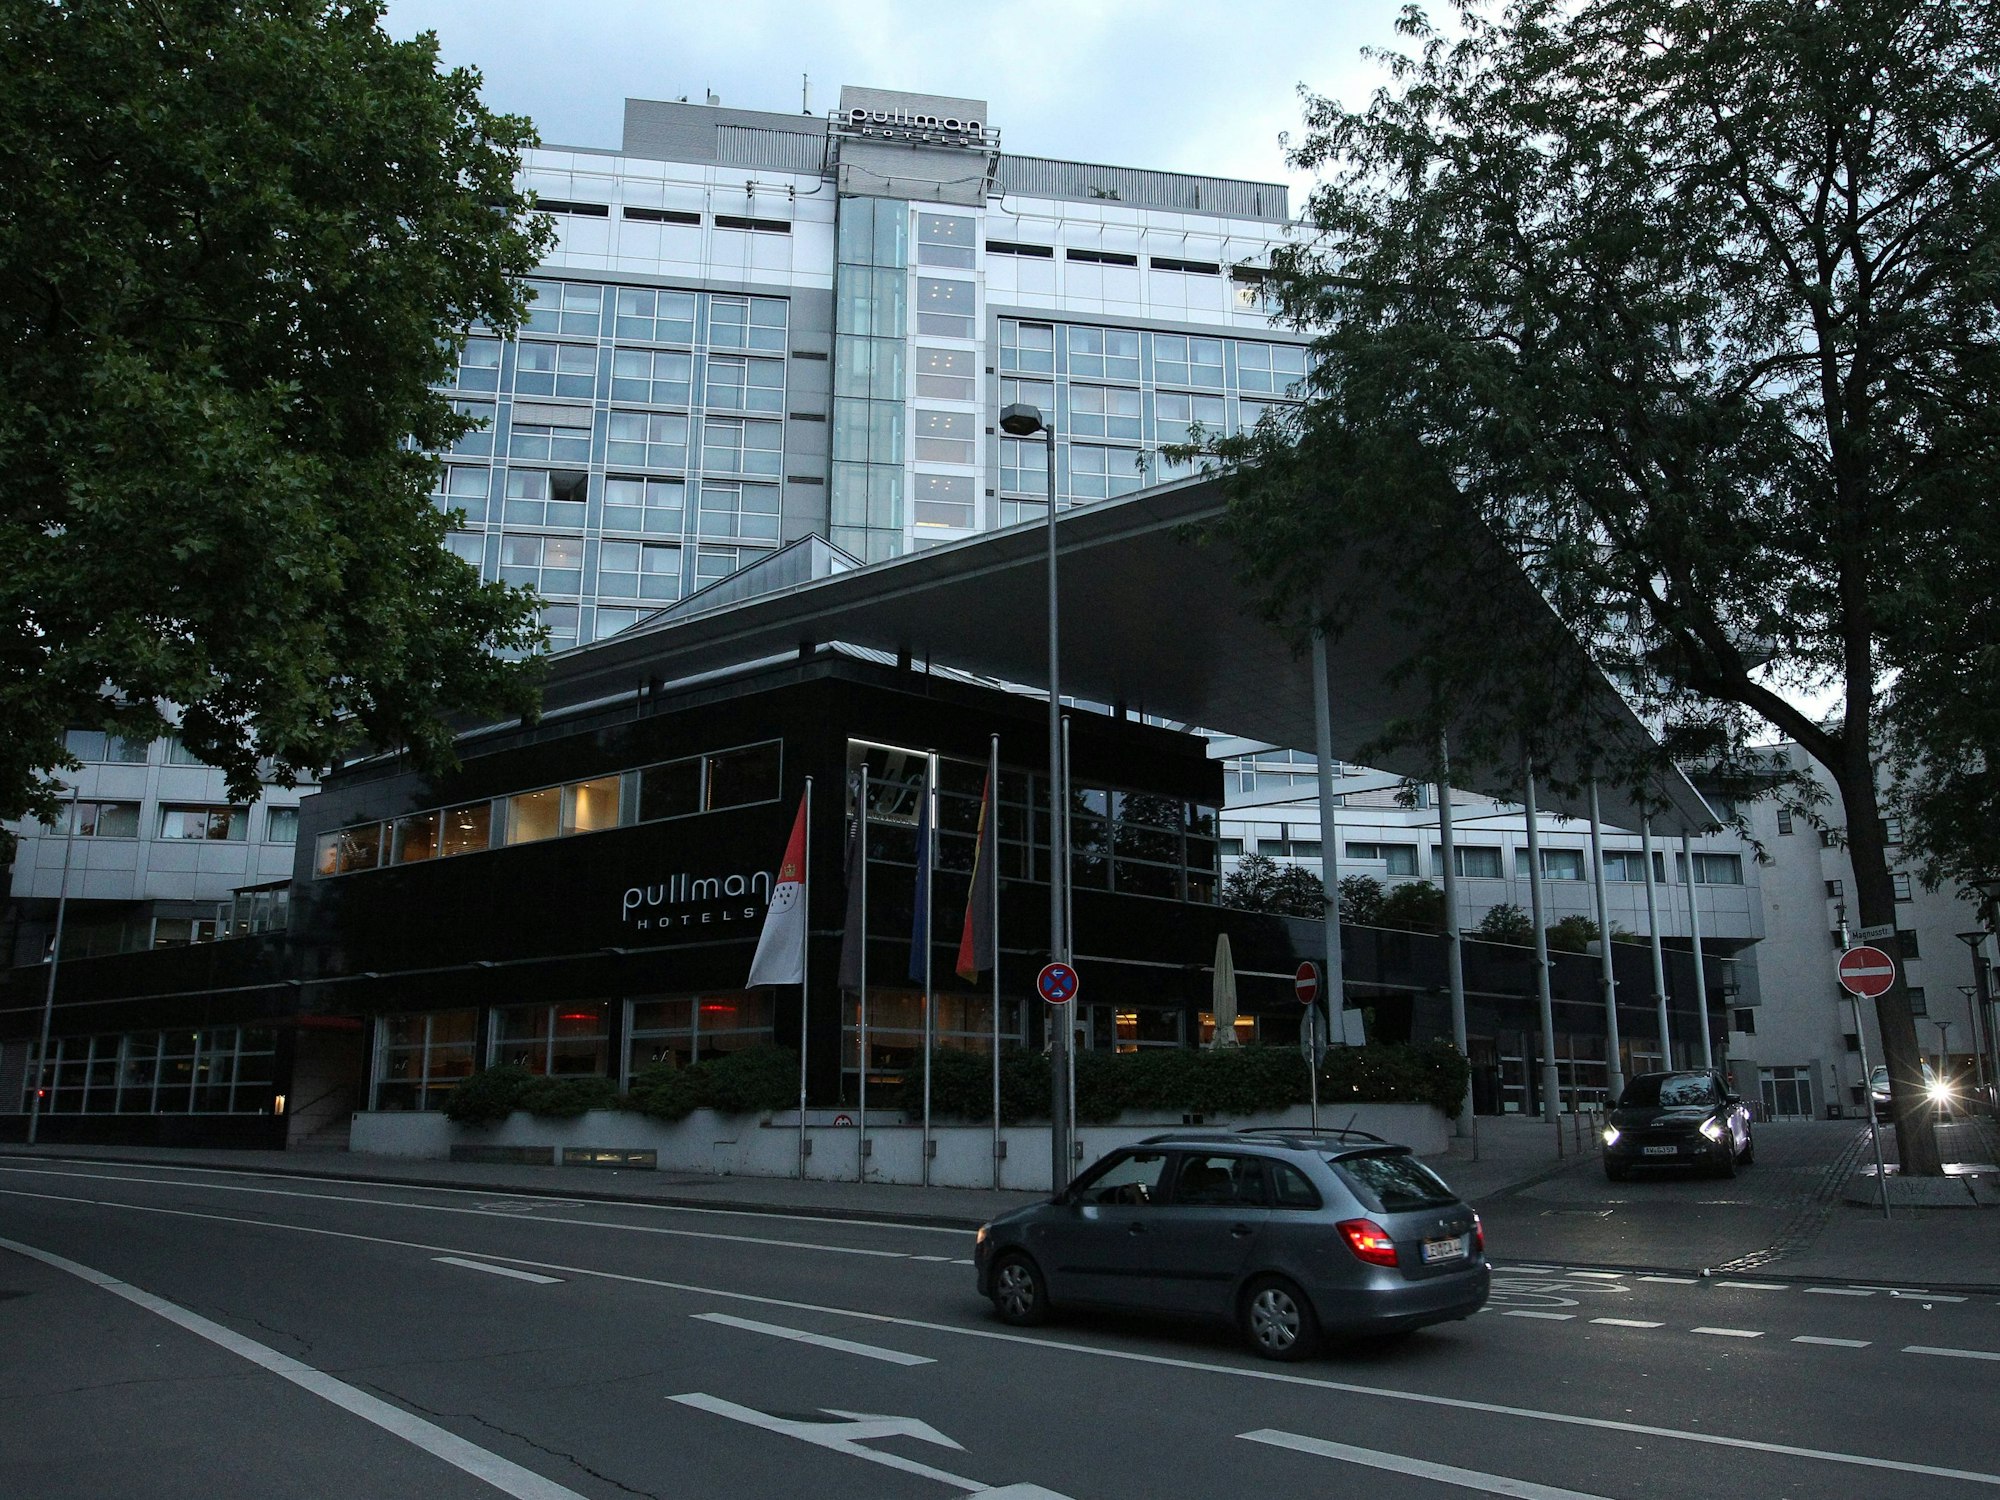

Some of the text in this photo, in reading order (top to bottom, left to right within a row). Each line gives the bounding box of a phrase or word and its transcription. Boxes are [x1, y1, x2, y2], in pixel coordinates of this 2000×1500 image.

[848, 107, 983, 141] pullman
[862, 128, 969, 146] HOTELS
[622, 870, 770, 922] pullman
[637, 907, 755, 931] HOTELS
[1852, 927, 1889, 940] Magnusstr.
